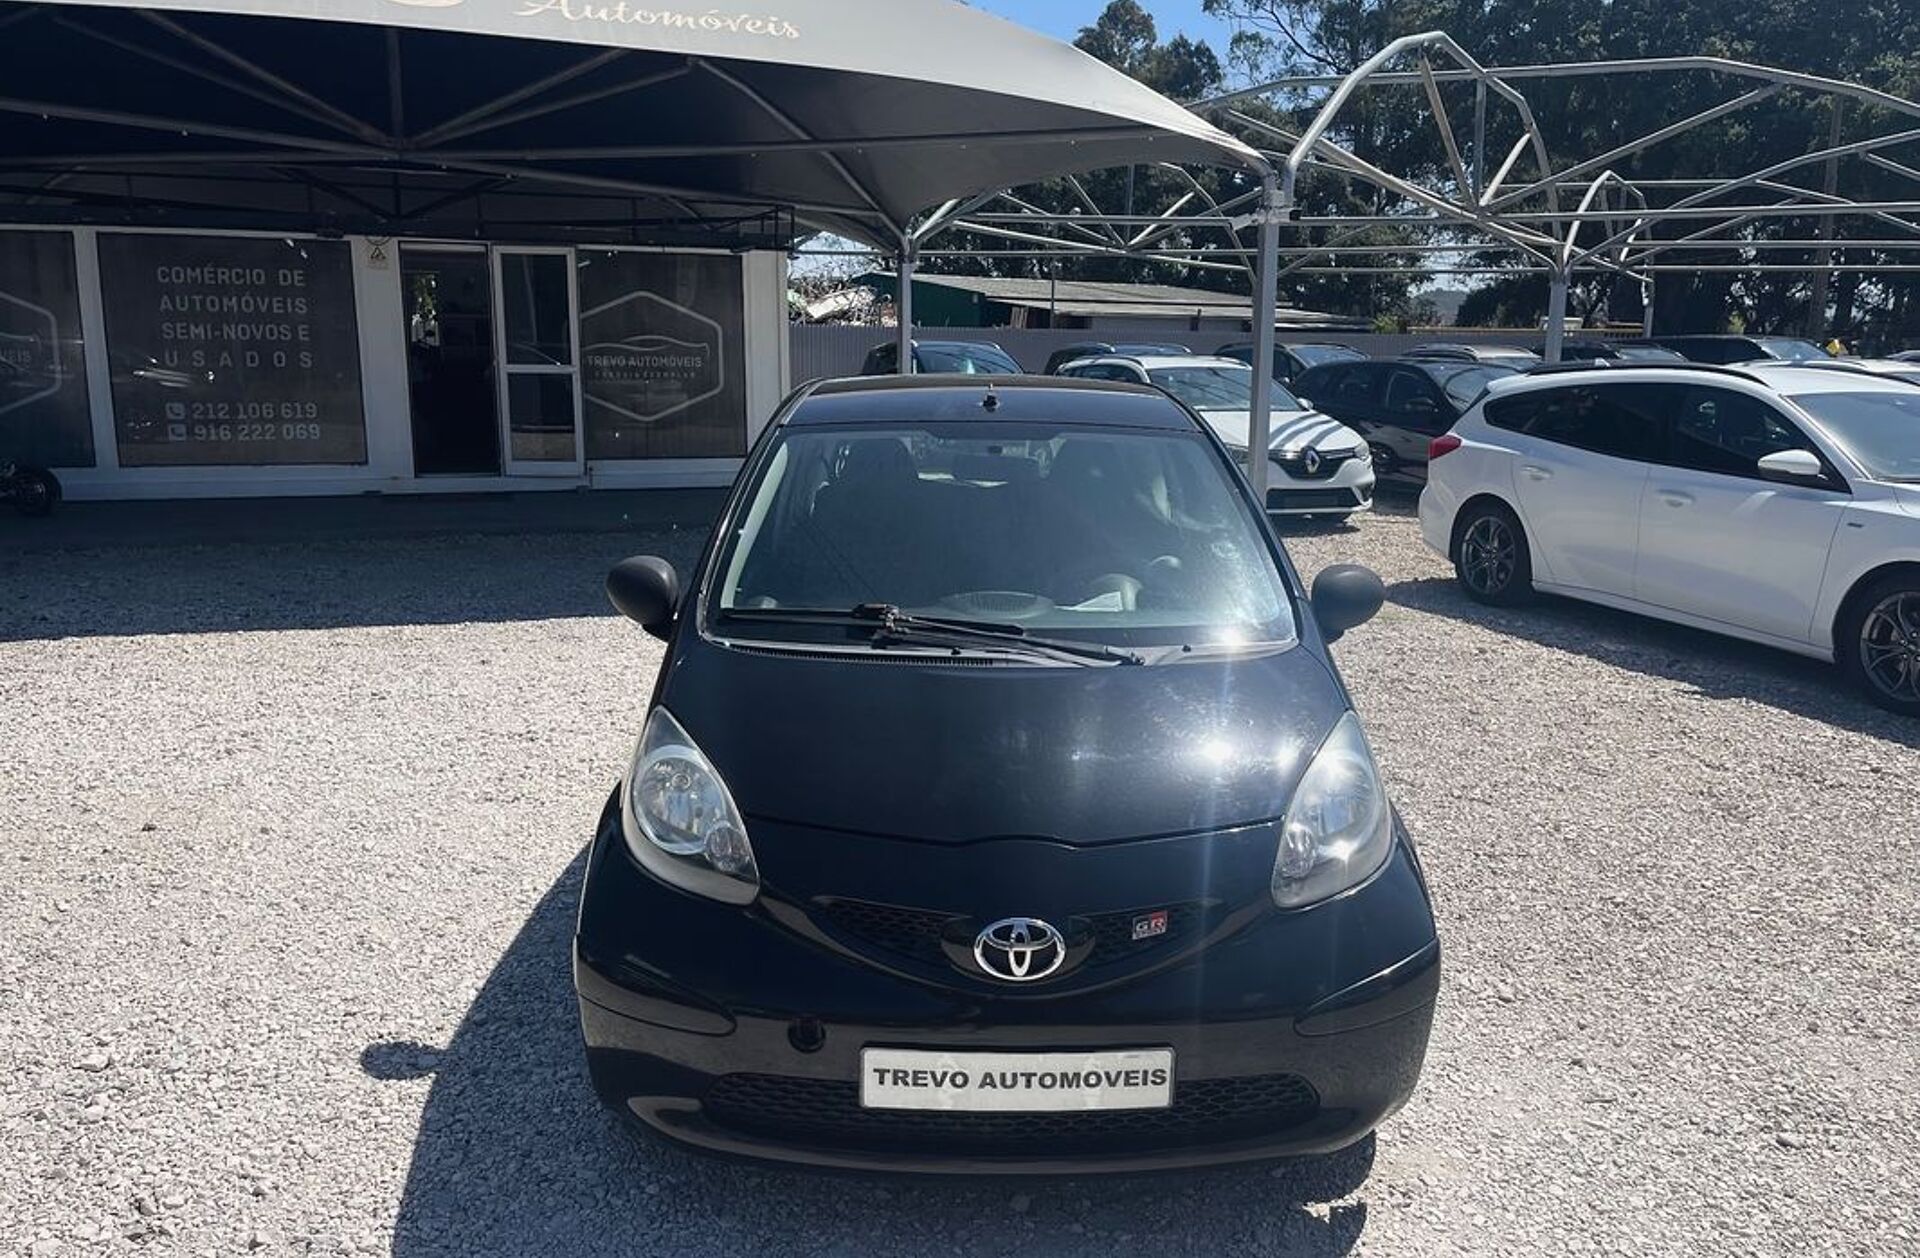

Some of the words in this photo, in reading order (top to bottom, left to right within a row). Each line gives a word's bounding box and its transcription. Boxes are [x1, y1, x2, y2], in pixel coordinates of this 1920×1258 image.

[512, 0, 800, 39] Automóveis
[157, 262, 266, 285] COMÉRCIO
[278, 268, 306, 286] DE
[159, 290, 308, 313] AUTOMÓVEIS
[161, 322, 291, 340] SEMI-NOVOS
[298, 324, 310, 341] E
[587, 355, 625, 367] TREVO
[192, 402, 230, 419] 212
[237, 402, 274, 419] 106
[281, 402, 318, 419] 619
[194, 424, 231, 440] 916
[238, 424, 276, 440] 222
[283, 423, 320, 440] 069
[1135, 917, 1165, 932] GR
[873, 1068, 970, 1089] TREVO
[978, 1069, 1168, 1089] AUTOMOVEIS
